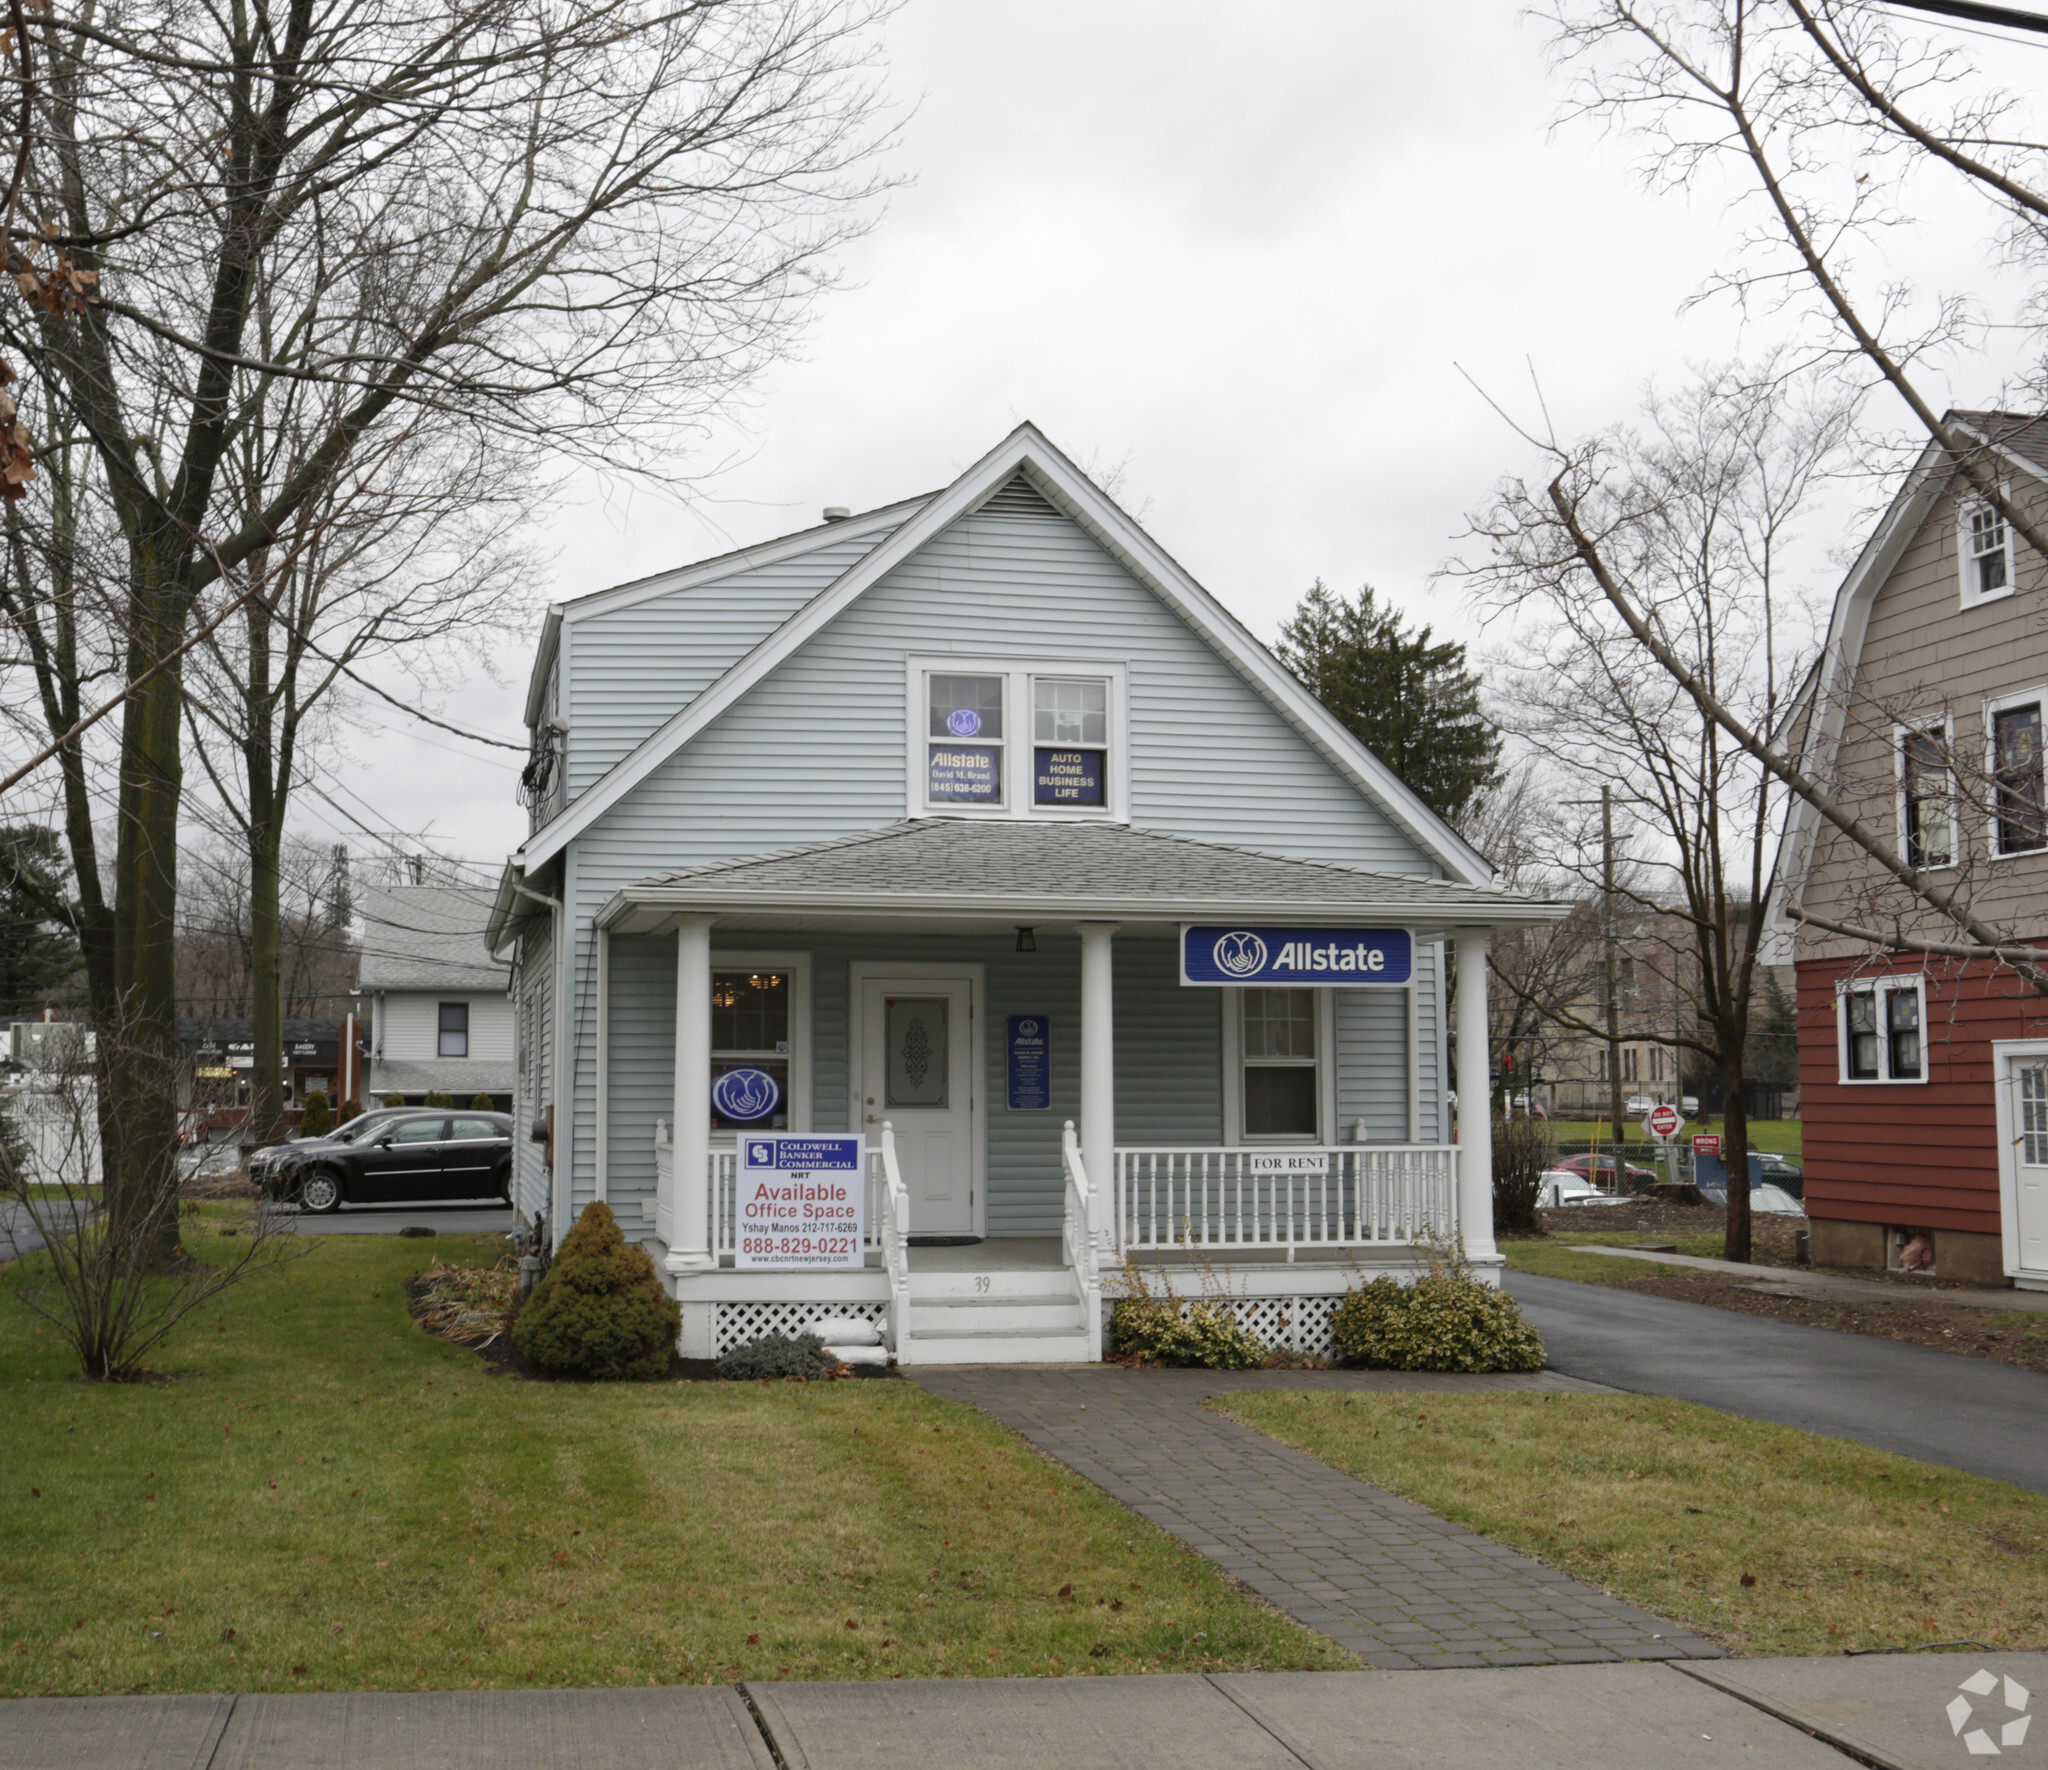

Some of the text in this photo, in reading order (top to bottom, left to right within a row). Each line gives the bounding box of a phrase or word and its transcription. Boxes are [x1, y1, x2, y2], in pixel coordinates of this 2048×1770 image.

[931, 752, 990, 768] Allstate
[1051, 753, 1082, 763] AUTO
[932, 770, 990, 780] David M. Brand
[1050, 764, 1083, 775] HOME
[1038, 776, 1094, 787] BUSINESS
[1055, 788, 1079, 798] LIFE
[1271, 942, 1385, 972] Allstate
[779, 1142, 842, 1150] COLDWELL
[779, 1151, 823, 1159] BANKER
[779, 1159, 855, 1168] COMMERCIAL
[1254, 1157, 1326, 1169] FOR RENT
[754, 1183, 847, 1201] Available
[745, 1203, 855, 1221] Office Space
[742, 1222, 858, 1235] Yshay Manos 212-717-6269
[743, 1237, 857, 1254] 888-829-0221
[975, 1276, 991, 1294] 39
